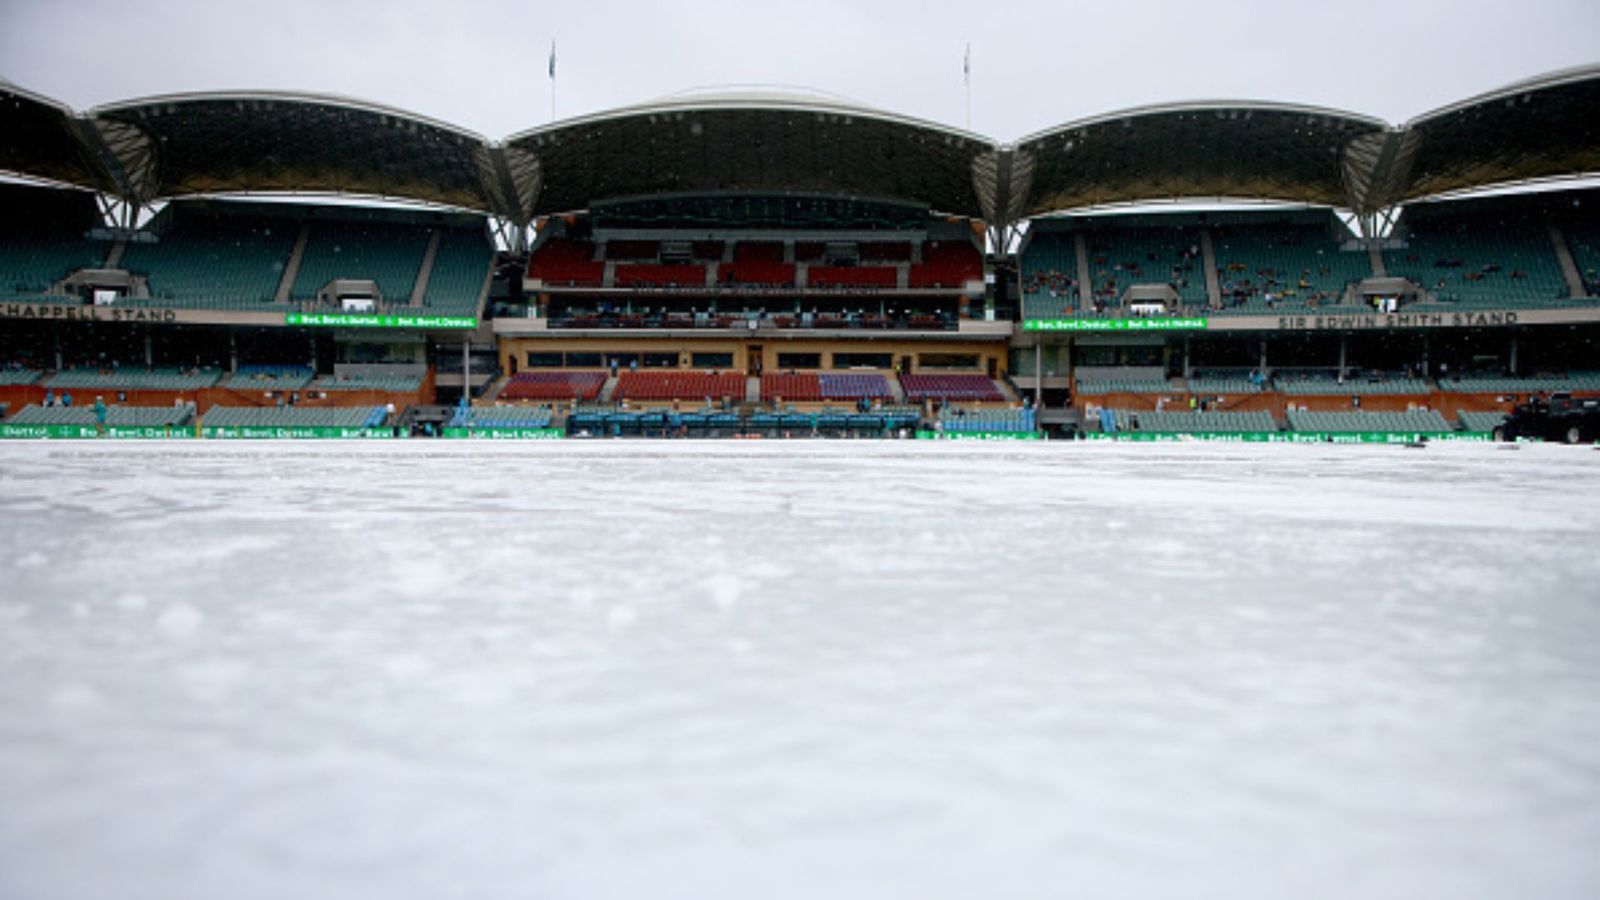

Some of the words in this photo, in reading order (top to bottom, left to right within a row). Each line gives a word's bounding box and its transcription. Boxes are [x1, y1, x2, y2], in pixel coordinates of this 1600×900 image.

[0, 303, 102, 320] HAPPELL
[112, 309, 176, 321] STAND
[1279, 317, 1305, 329] SIR
[1316, 315, 1376, 328] EDWIN
[1387, 313, 1442, 327] SMITH
[1453, 311, 1517, 326] STAND
